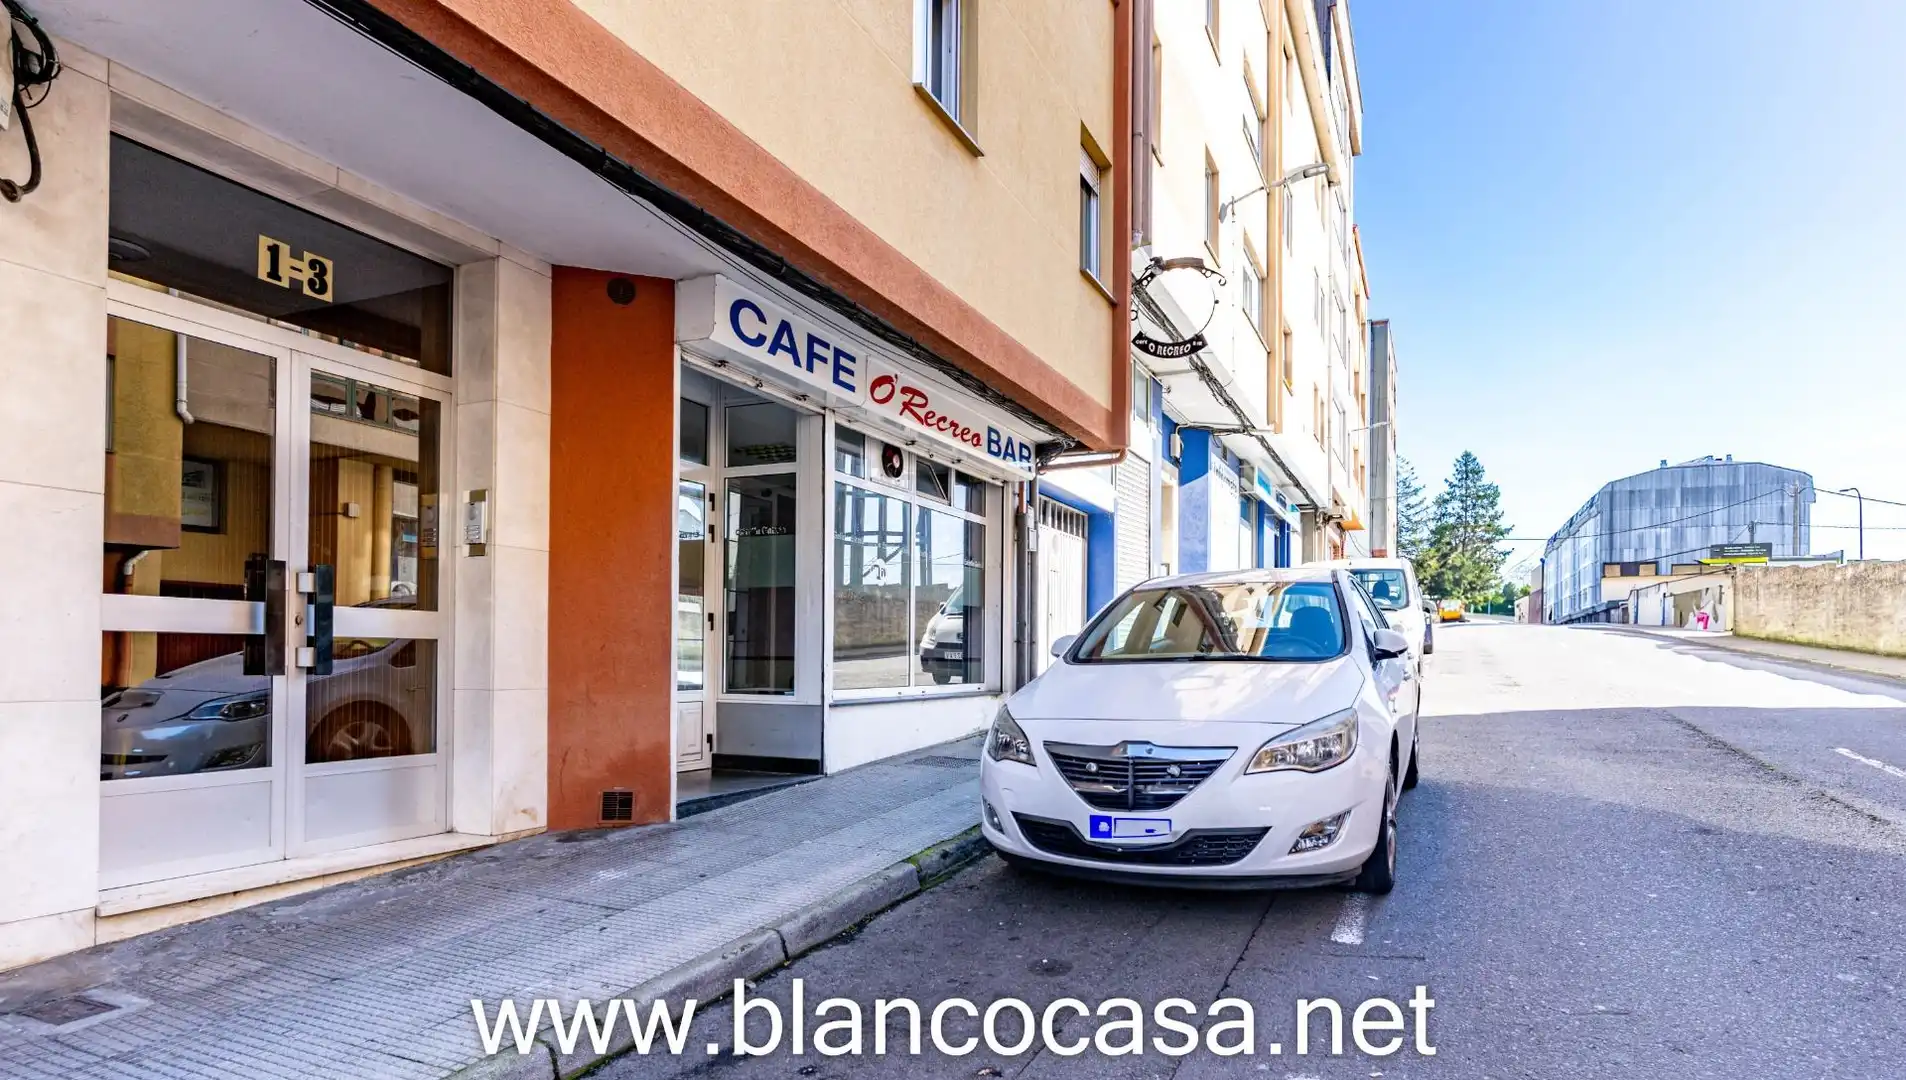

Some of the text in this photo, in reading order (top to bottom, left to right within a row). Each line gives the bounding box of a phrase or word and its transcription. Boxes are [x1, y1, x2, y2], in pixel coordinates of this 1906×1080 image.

[266, 243, 328, 296] 1-3
[1156, 343, 1192, 356] RECREO
[729, 298, 857, 394] CAFE
[987, 425, 1032, 472] BAR
